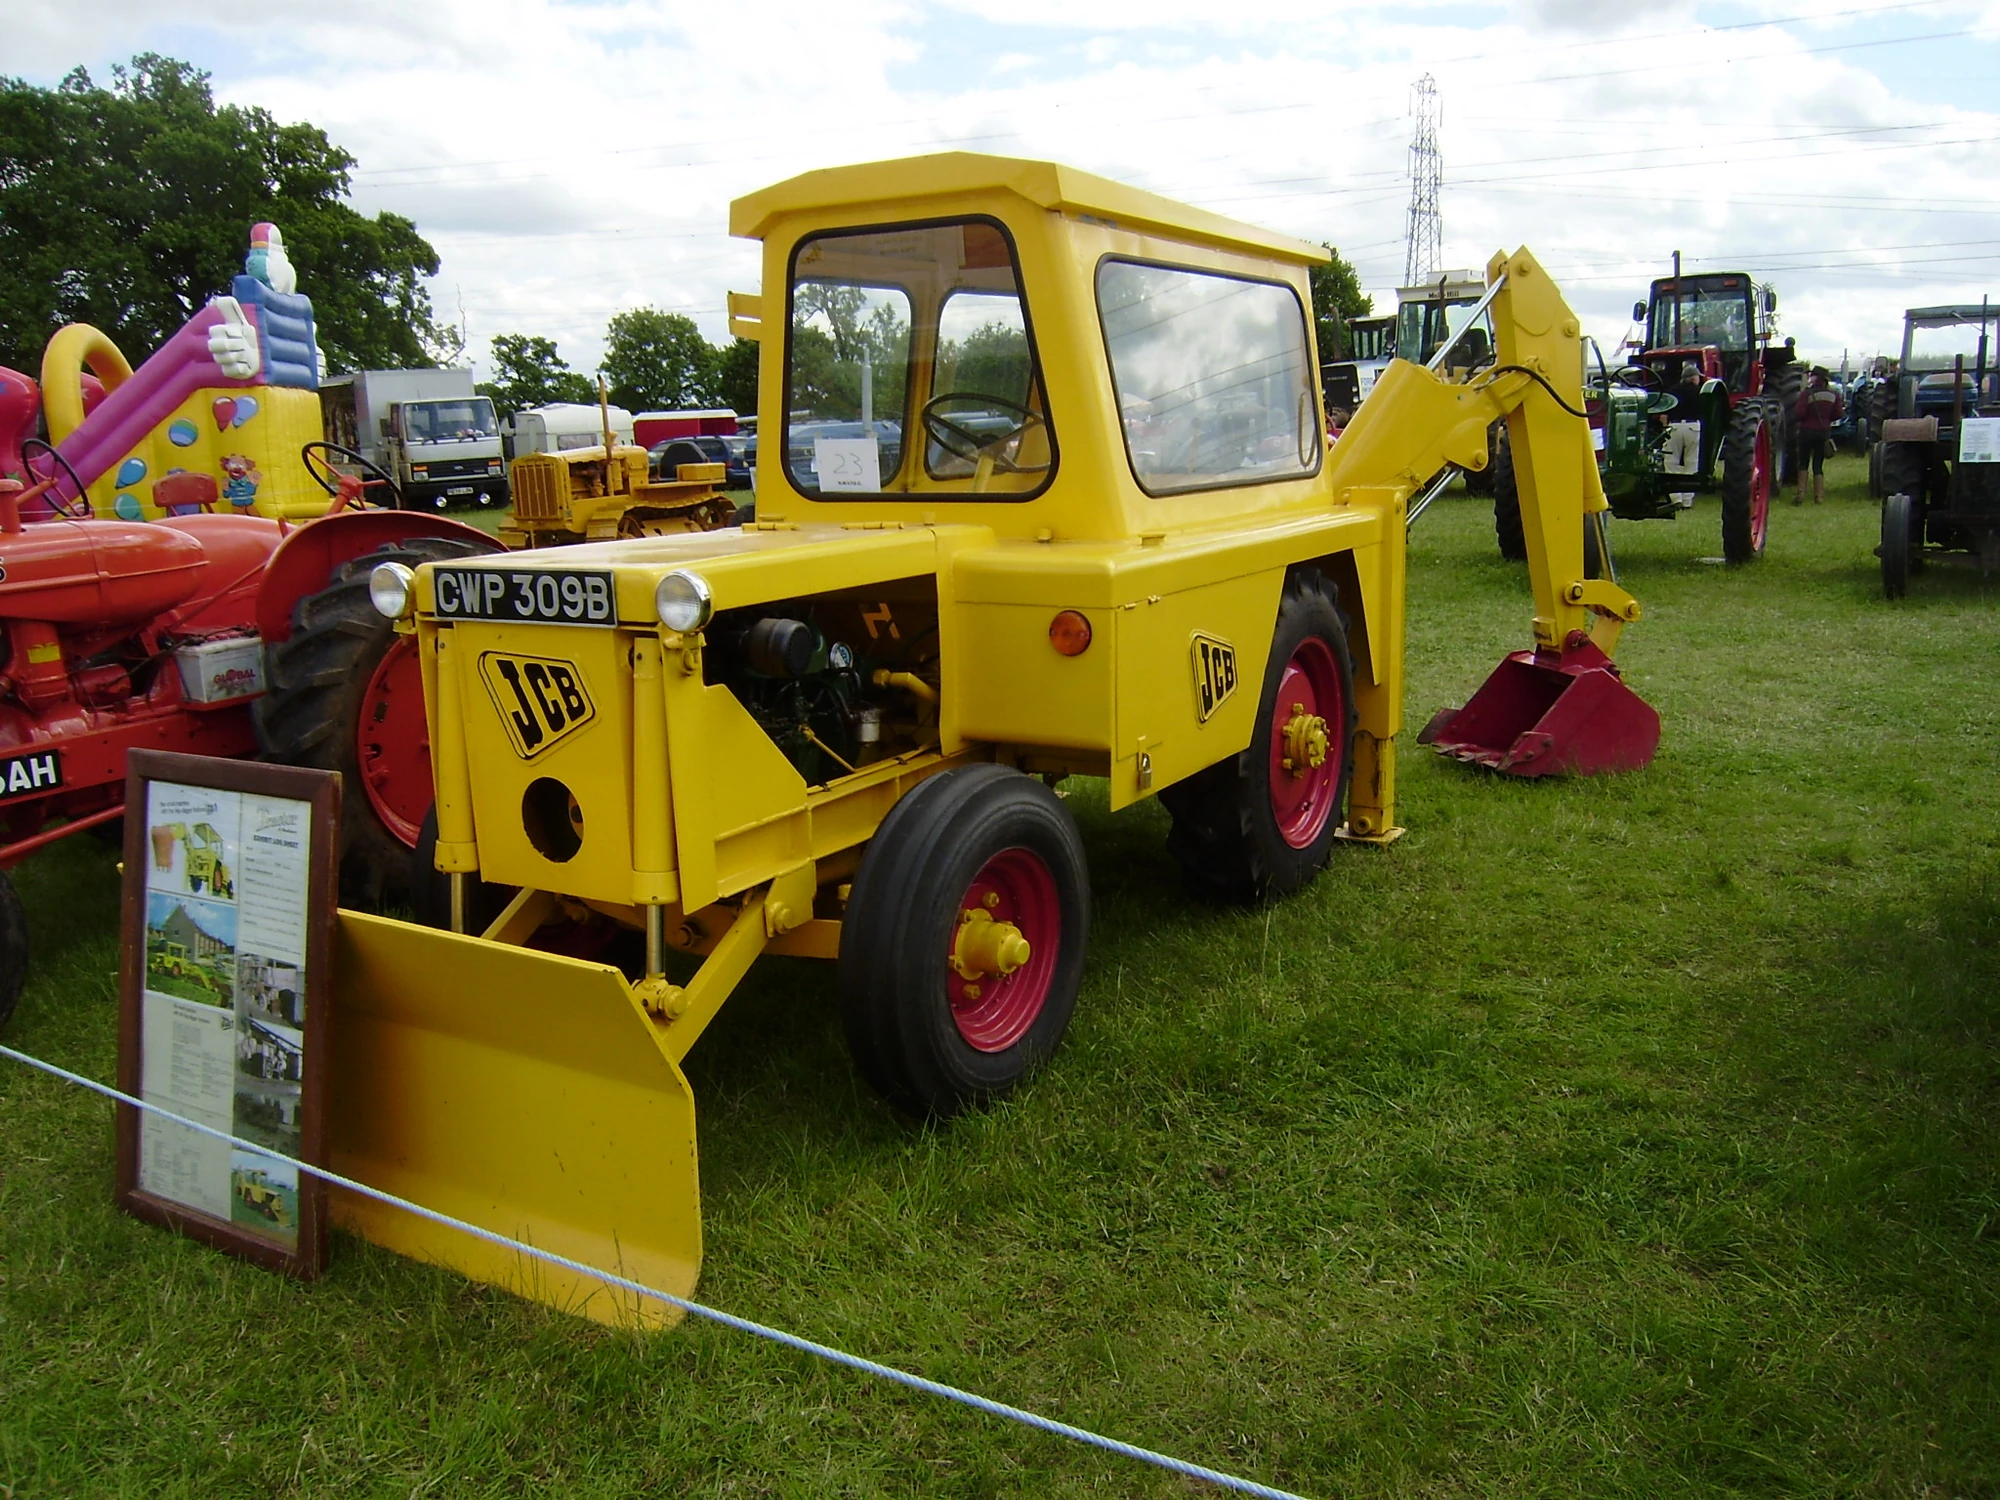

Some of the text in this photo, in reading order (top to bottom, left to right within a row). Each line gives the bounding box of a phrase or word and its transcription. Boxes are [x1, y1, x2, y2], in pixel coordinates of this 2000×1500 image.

[833, 452, 863, 476] 23
[437, 572, 610, 620] CWP 309B
[213, 668, 256, 684] GLOBAL
[1200, 642, 1234, 715] JCB
[496, 659, 586, 750] JCB
[0, 755, 57, 794] AH
